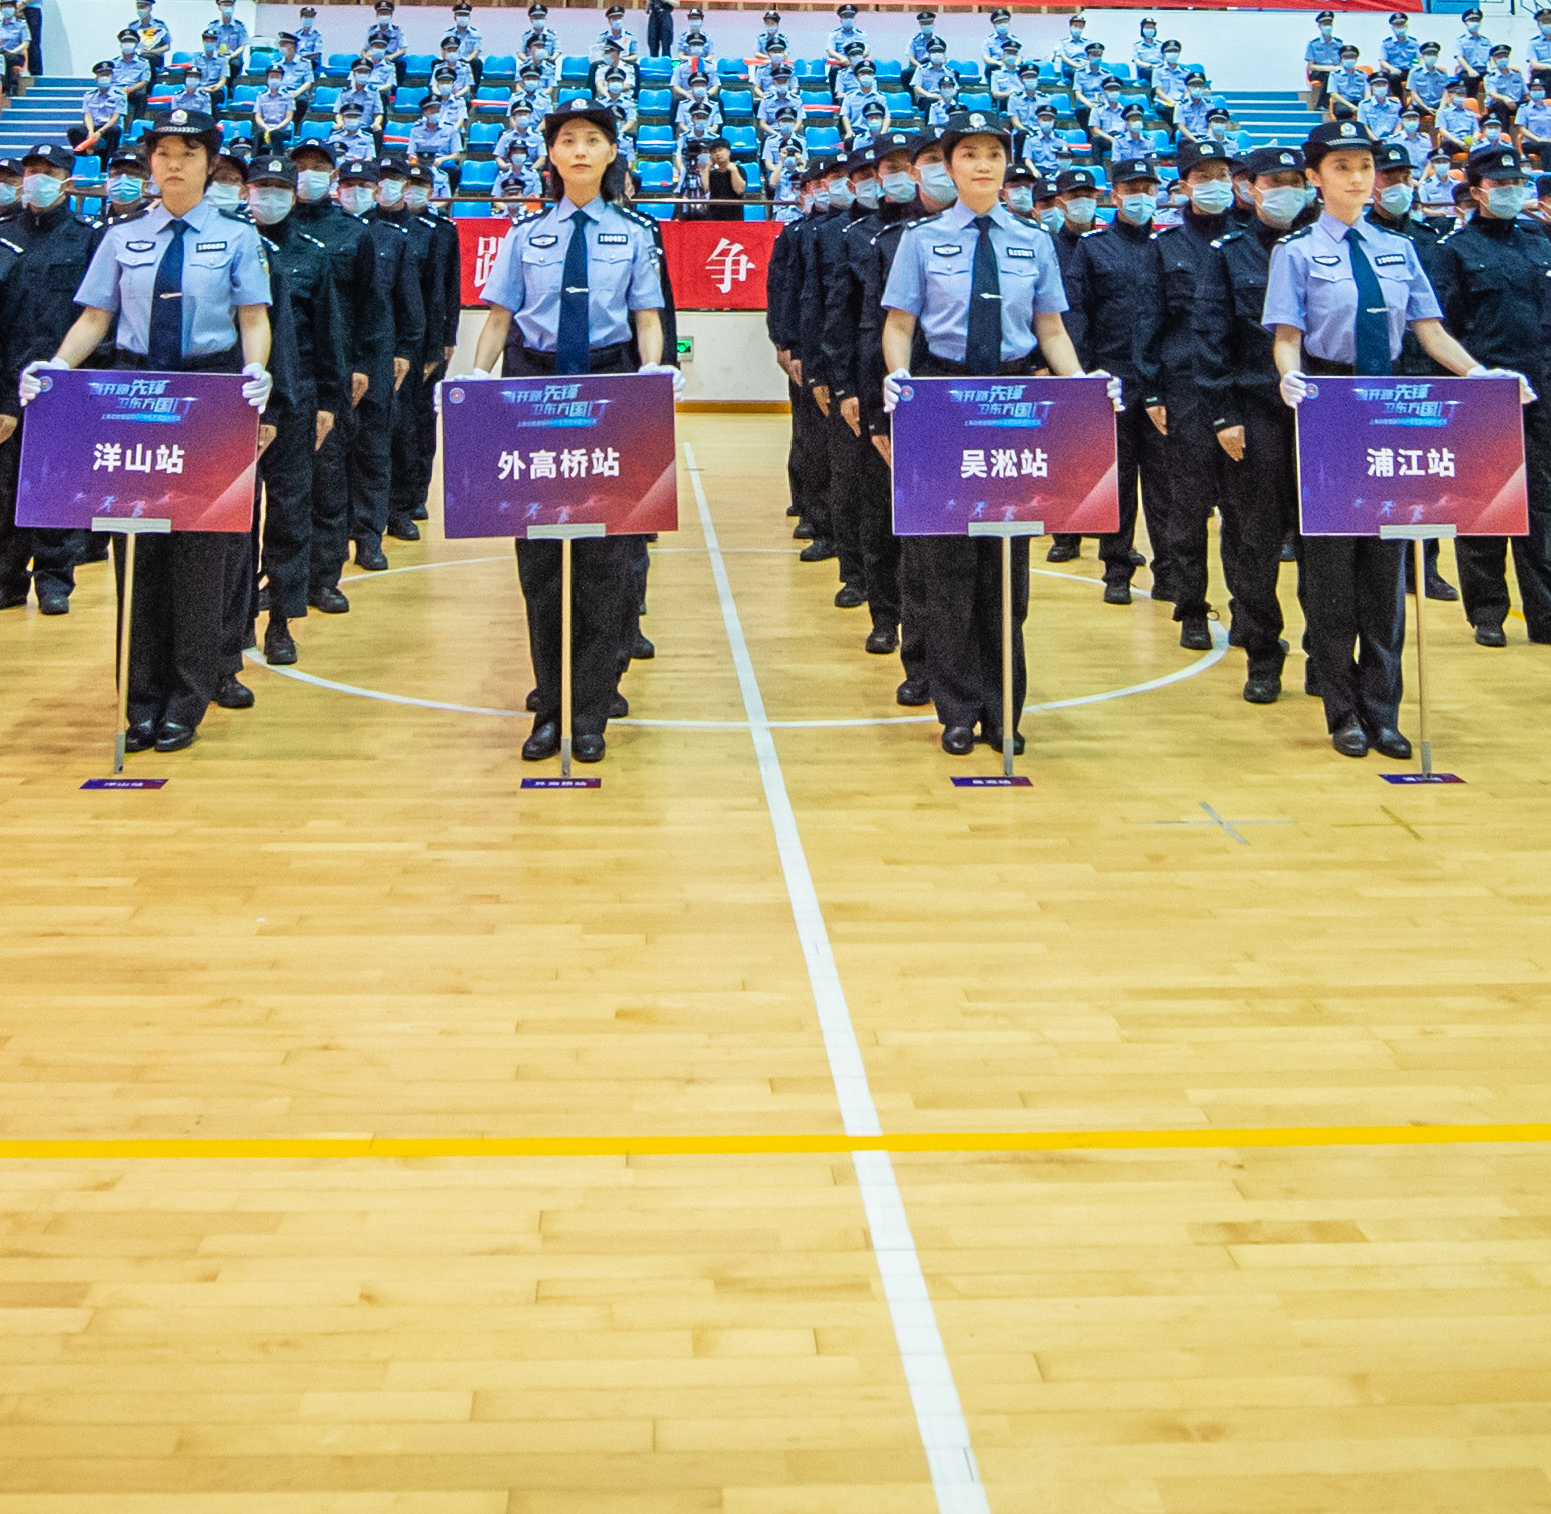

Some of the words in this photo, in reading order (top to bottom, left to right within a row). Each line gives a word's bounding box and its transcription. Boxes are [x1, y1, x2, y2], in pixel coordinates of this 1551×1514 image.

[706, 237, 756, 294] 争
[93, 443, 185, 474] 洋山站
[498, 447, 620, 480] 外高桥站
[961, 448, 1048, 478] 吴淞站
[1367, 448, 1455, 477] 浦江站
